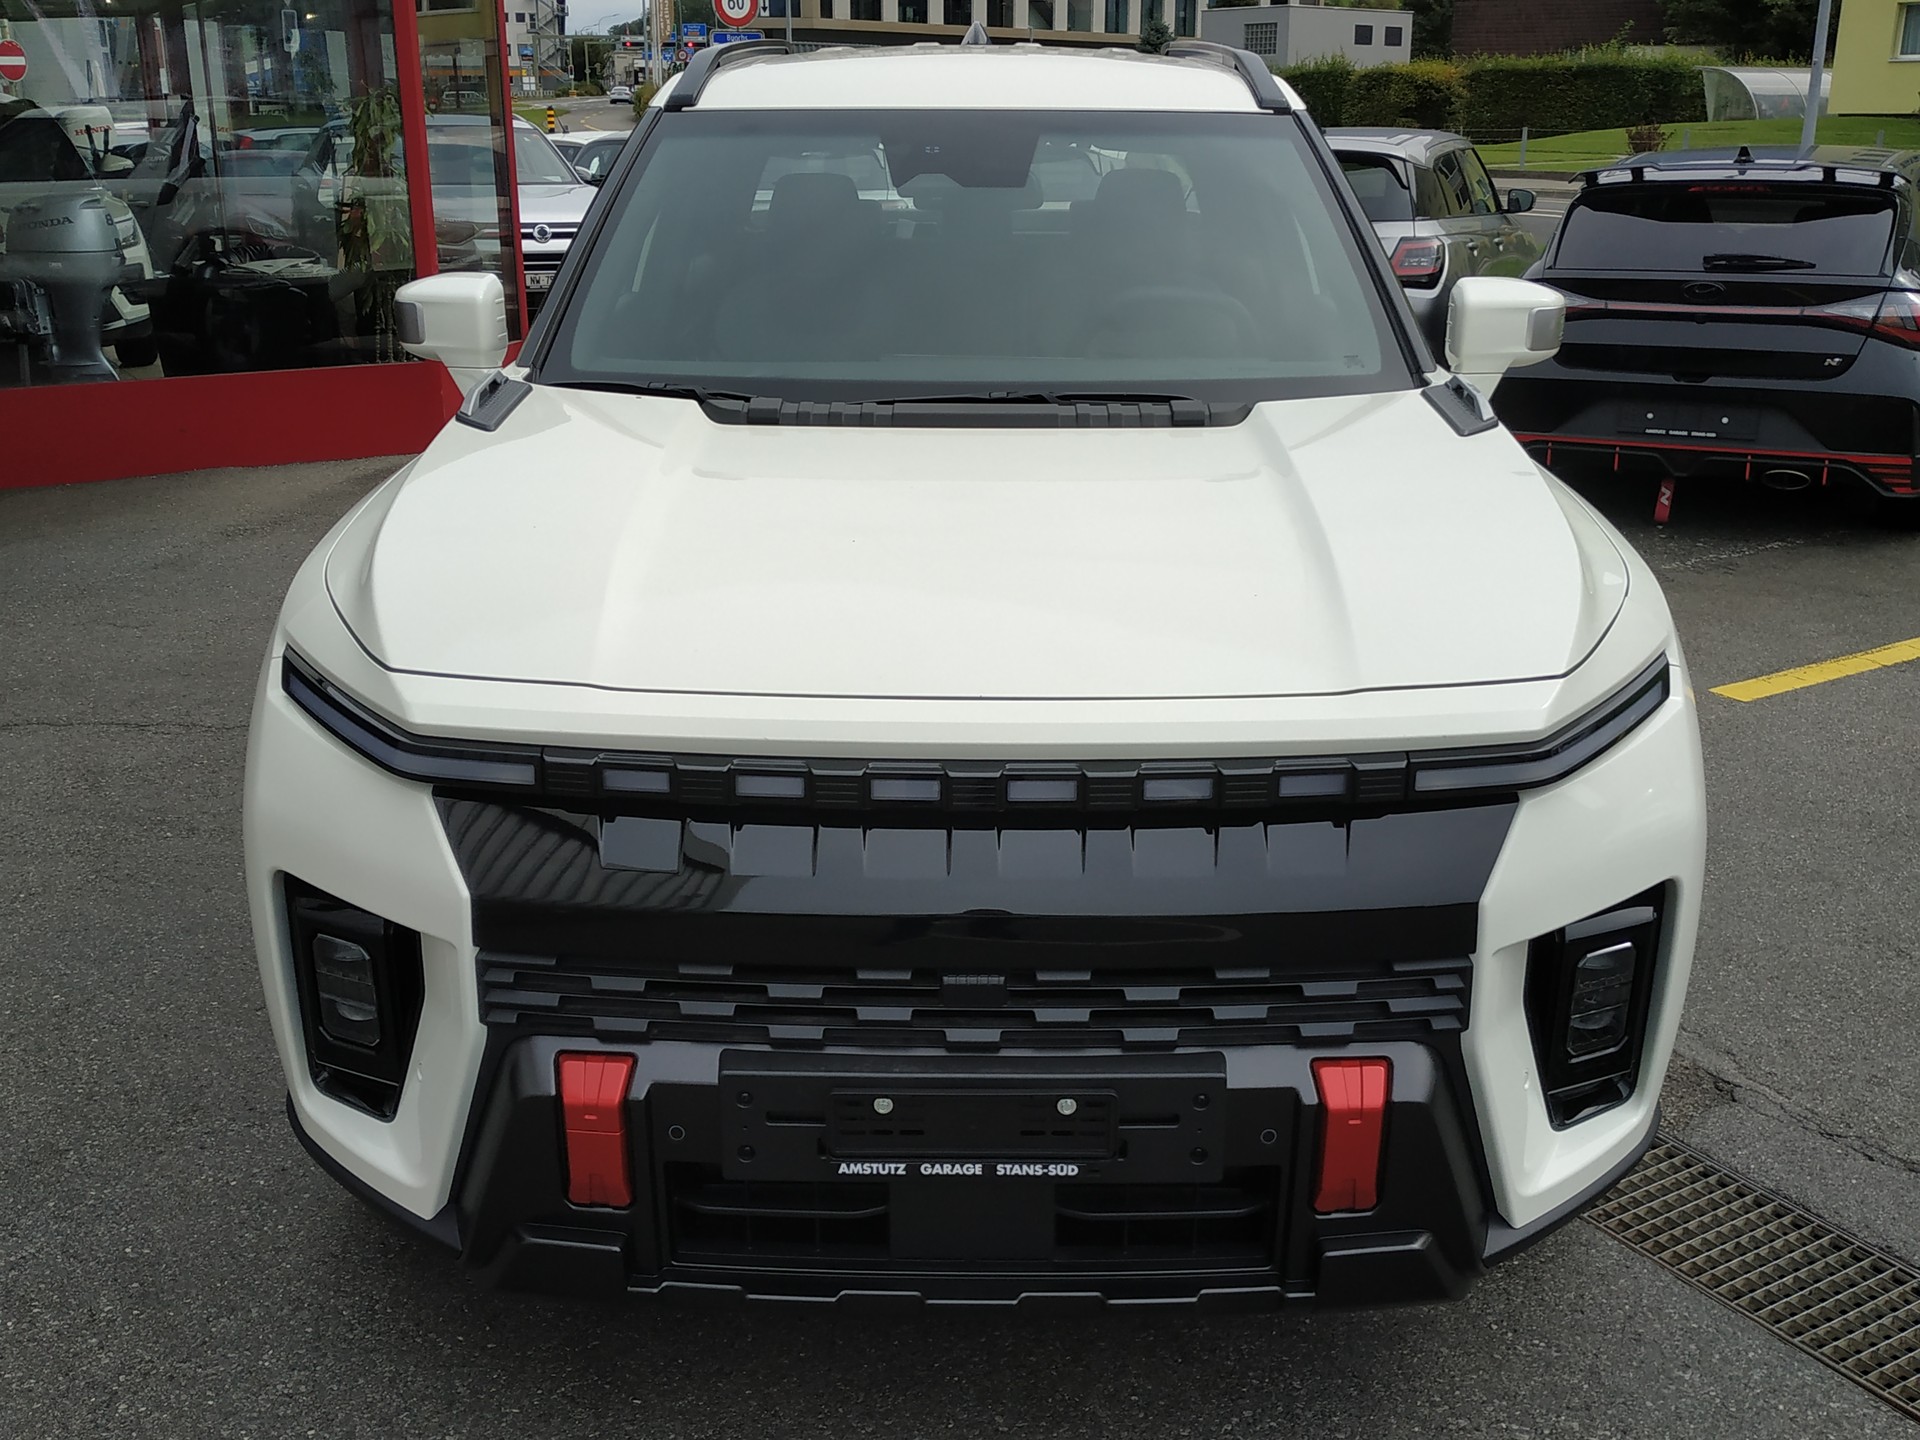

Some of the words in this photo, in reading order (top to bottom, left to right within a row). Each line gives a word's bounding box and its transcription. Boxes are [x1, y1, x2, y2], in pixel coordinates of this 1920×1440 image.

[838, 1163, 907, 1175] AMSTUTZ
[920, 1164, 983, 1175] GARAGE
[996, 1163, 1079, 1176] STANS-SÜD
